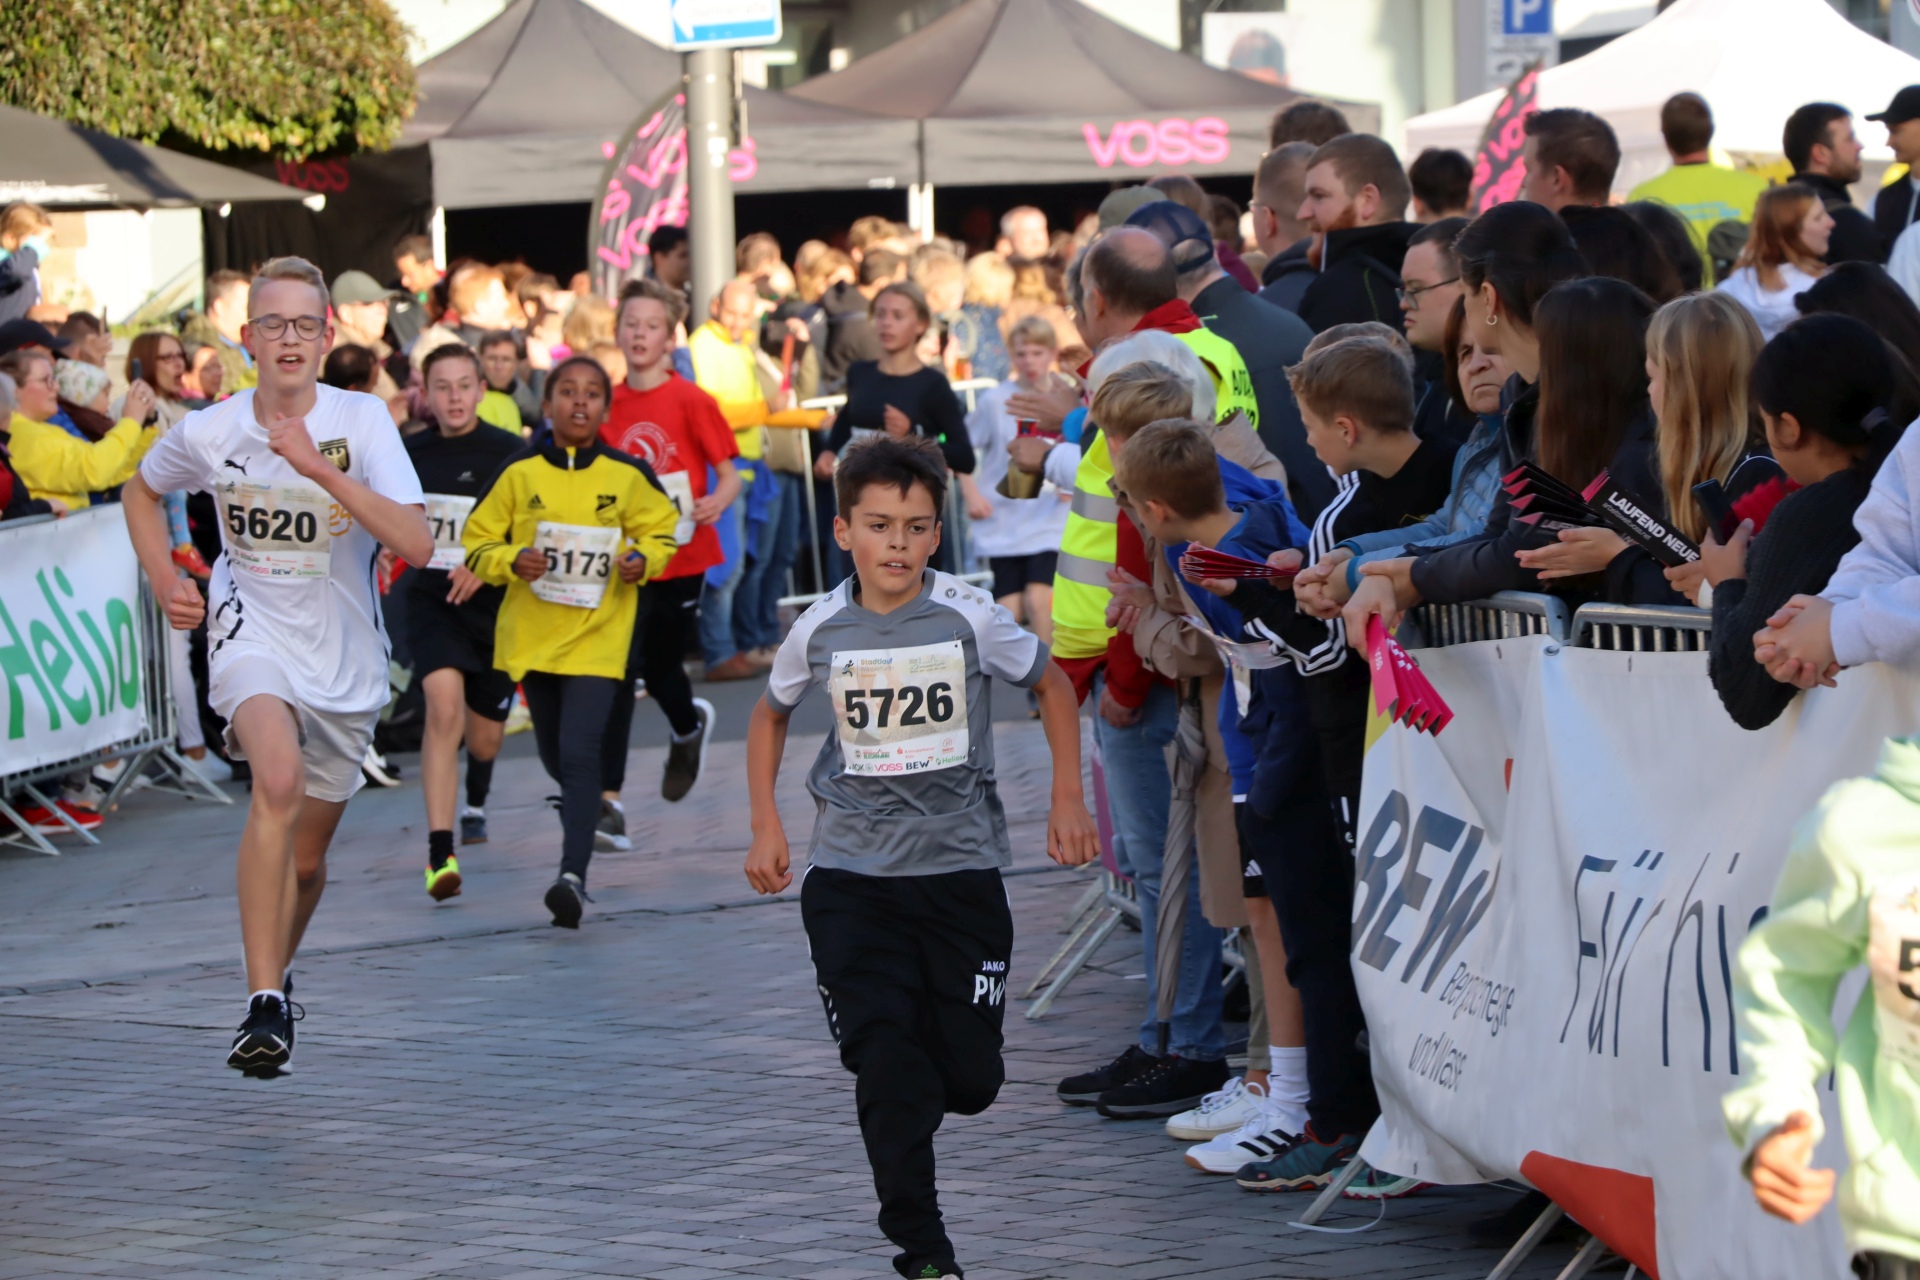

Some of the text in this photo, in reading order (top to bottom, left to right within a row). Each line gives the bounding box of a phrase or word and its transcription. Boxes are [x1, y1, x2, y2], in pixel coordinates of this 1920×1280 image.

[1512, 0, 1543, 31] P
[1082, 117, 1230, 168] VOSS
[227, 503, 317, 543] 5620
[427, 516, 456, 541] 71
[1608, 492, 1700, 562] LAUFEND NEUE
[543, 546, 611, 578] 5173
[0, 565, 141, 740] Helio
[845, 682, 954, 729] 5726
[875, 763, 903, 772] VOSS
[906, 759, 930, 770] BEW
[1351, 789, 1502, 993] BEW
[982, 960, 1006, 972] JAKO
[1559, 849, 1770, 1075] Für hi
